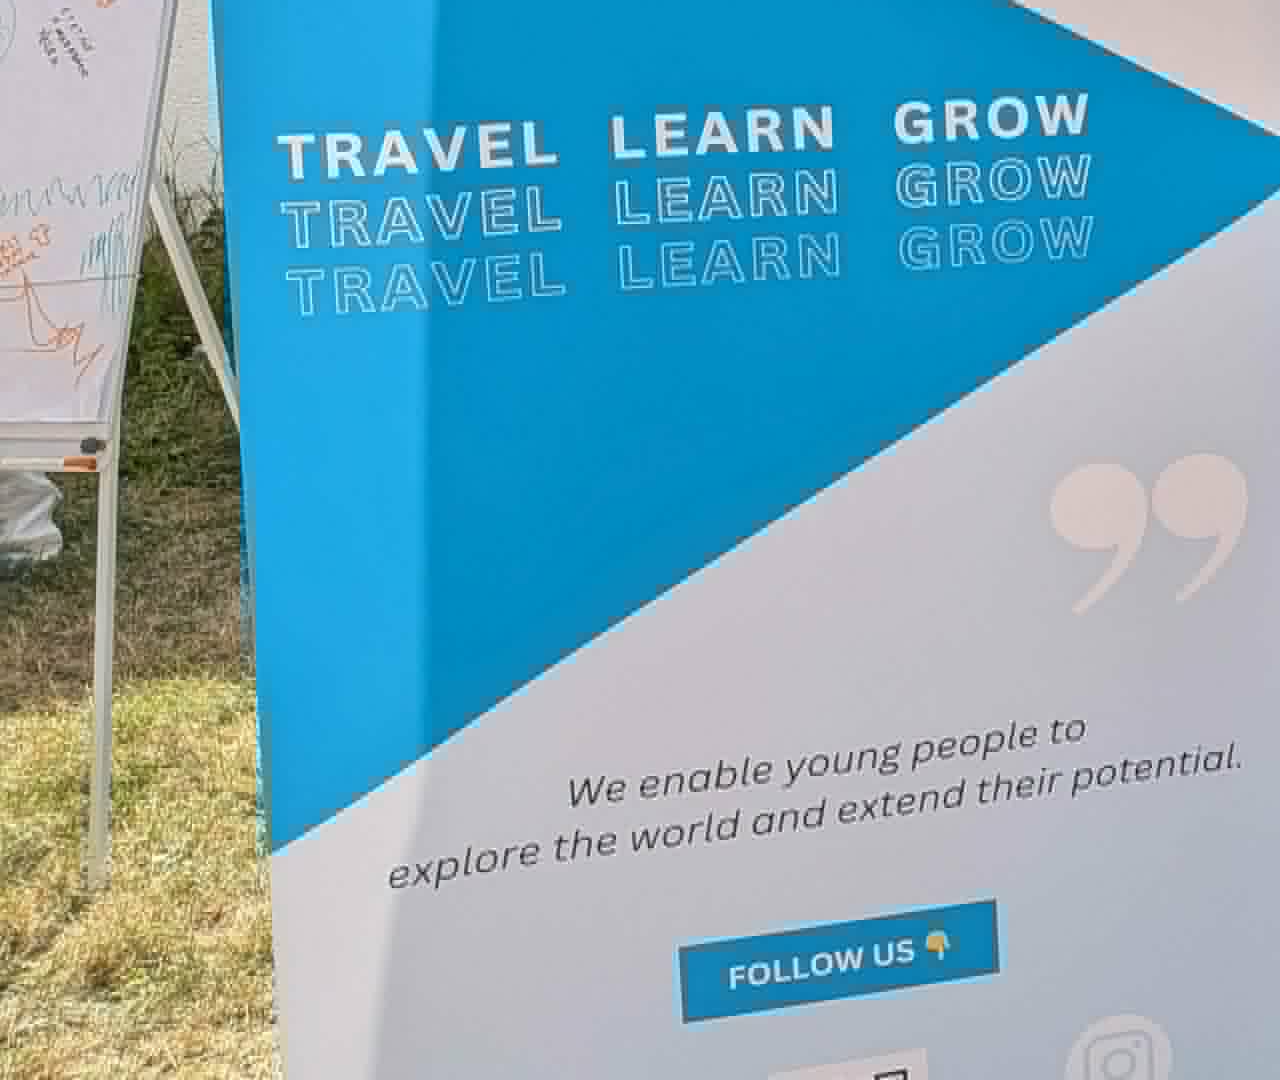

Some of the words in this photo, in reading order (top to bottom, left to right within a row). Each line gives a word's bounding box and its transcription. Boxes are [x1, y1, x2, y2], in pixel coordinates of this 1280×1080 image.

[277, 120, 561, 182] TRAVEL
[610, 105, 835, 160] LEARN
[892, 92, 1090, 146] GROW
[279, 184, 563, 251] TRAVEL
[614, 169, 838, 226] LEARN
[894, 153, 1093, 210] GROW
[285, 251, 566, 318] TRAVEL
[618, 232, 841, 292] LEARN
[896, 214, 1096, 273] GROW
[568, 772, 627, 810] We
[638, 756, 774, 799] enable
[782, 742, 902, 788] young
[910, 721, 1038, 769] people
[1048, 718, 1088, 745] to
[387, 840, 540, 890] explore
[552, 826, 619, 862] the
[629, 809, 740, 853] world
[749, 798, 827, 834] and
[836, 780, 967, 825] extend
[975, 768, 1064, 806] their
[1070, 741, 1243, 800] potential.
[728, 945, 863, 990] FOLLOW
[872, 939, 916, 968] US
